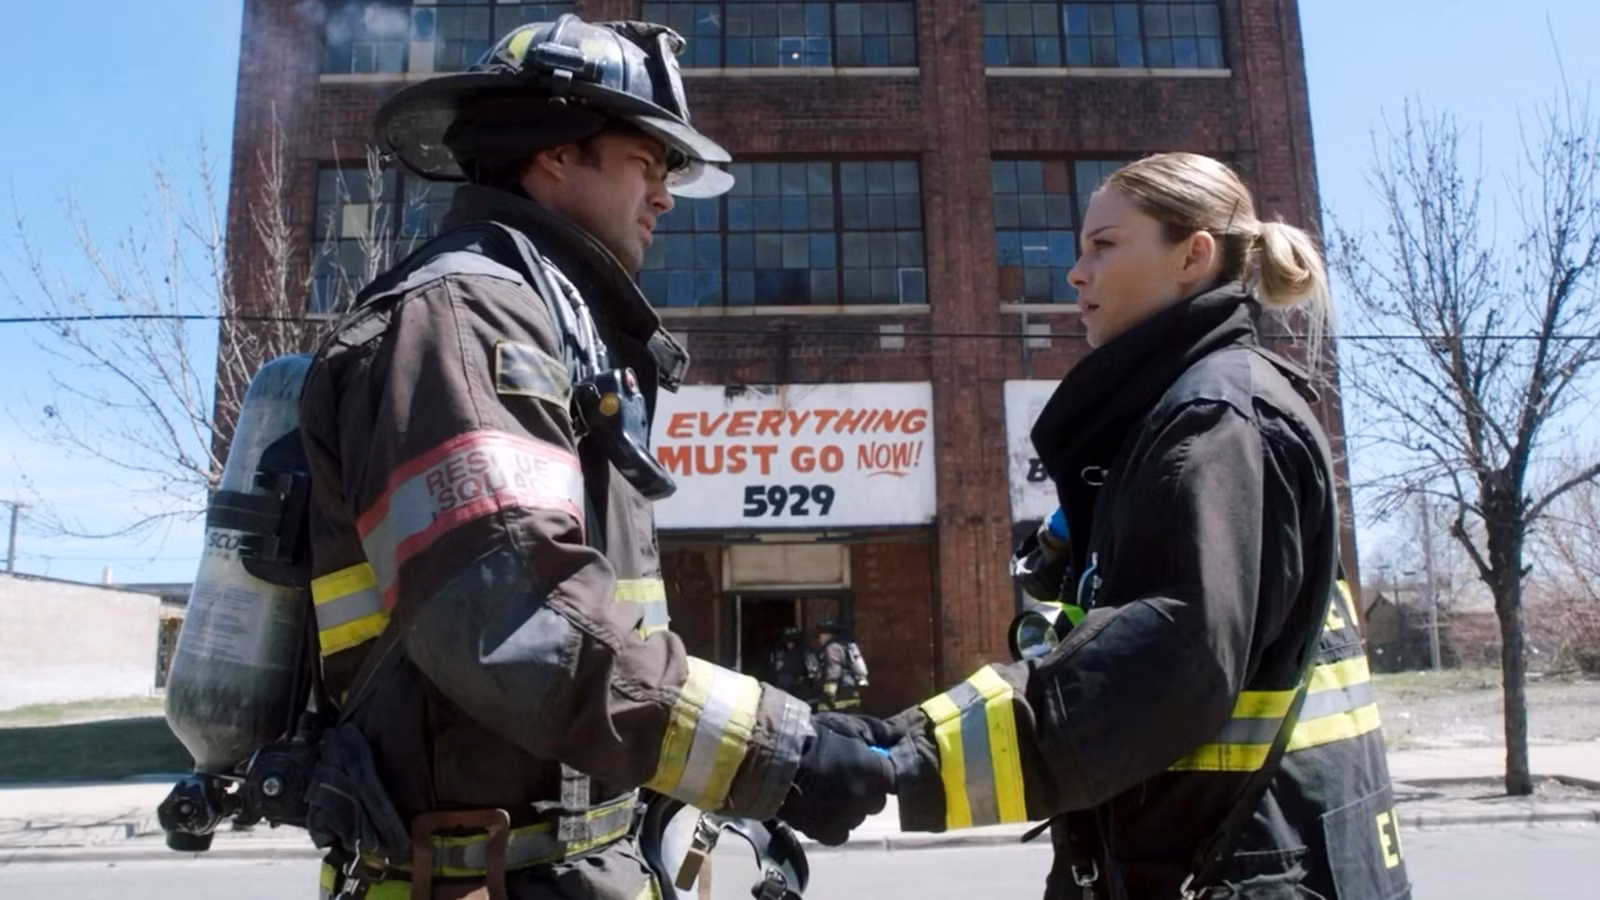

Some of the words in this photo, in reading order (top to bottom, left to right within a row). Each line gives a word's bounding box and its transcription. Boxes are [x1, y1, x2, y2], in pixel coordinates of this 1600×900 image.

[666, 408, 928, 439] EVERYTHING
[656, 444, 778, 477] MUST
[790, 445, 844, 474] GO
[856, 440, 924, 472] NOW!
[743, 484, 836, 518] 5929
